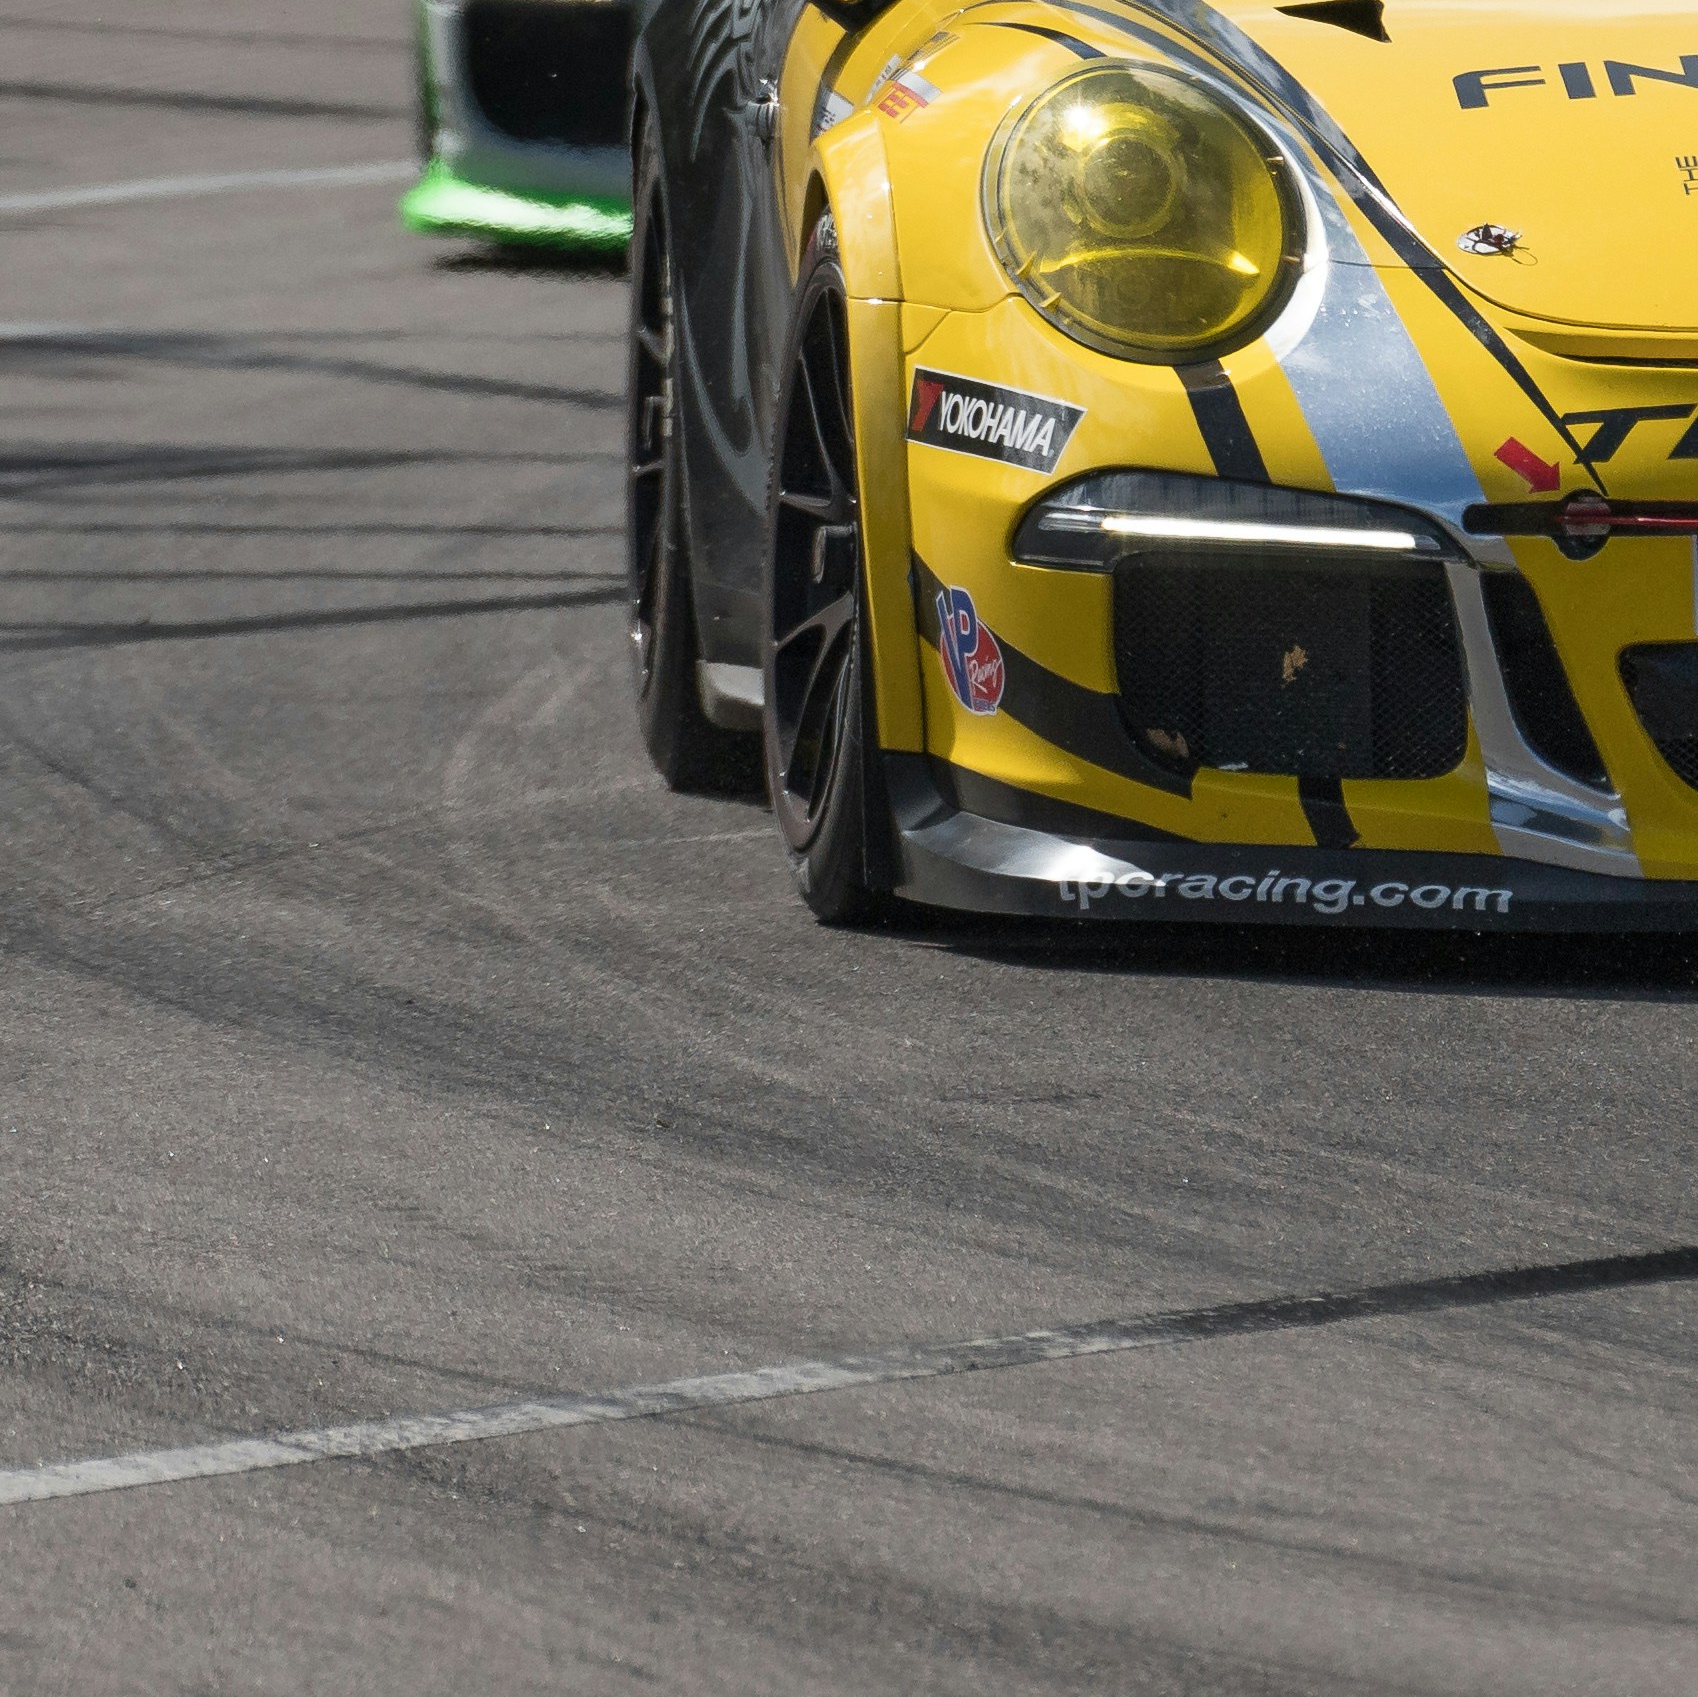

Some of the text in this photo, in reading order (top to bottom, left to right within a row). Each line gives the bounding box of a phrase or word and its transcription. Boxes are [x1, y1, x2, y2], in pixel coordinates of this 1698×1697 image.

[939, 390, 1056, 457] YOKOHAMA
[936, 585, 979, 712] VP
[1057, 869, 1514, 915] tpcracing.com
